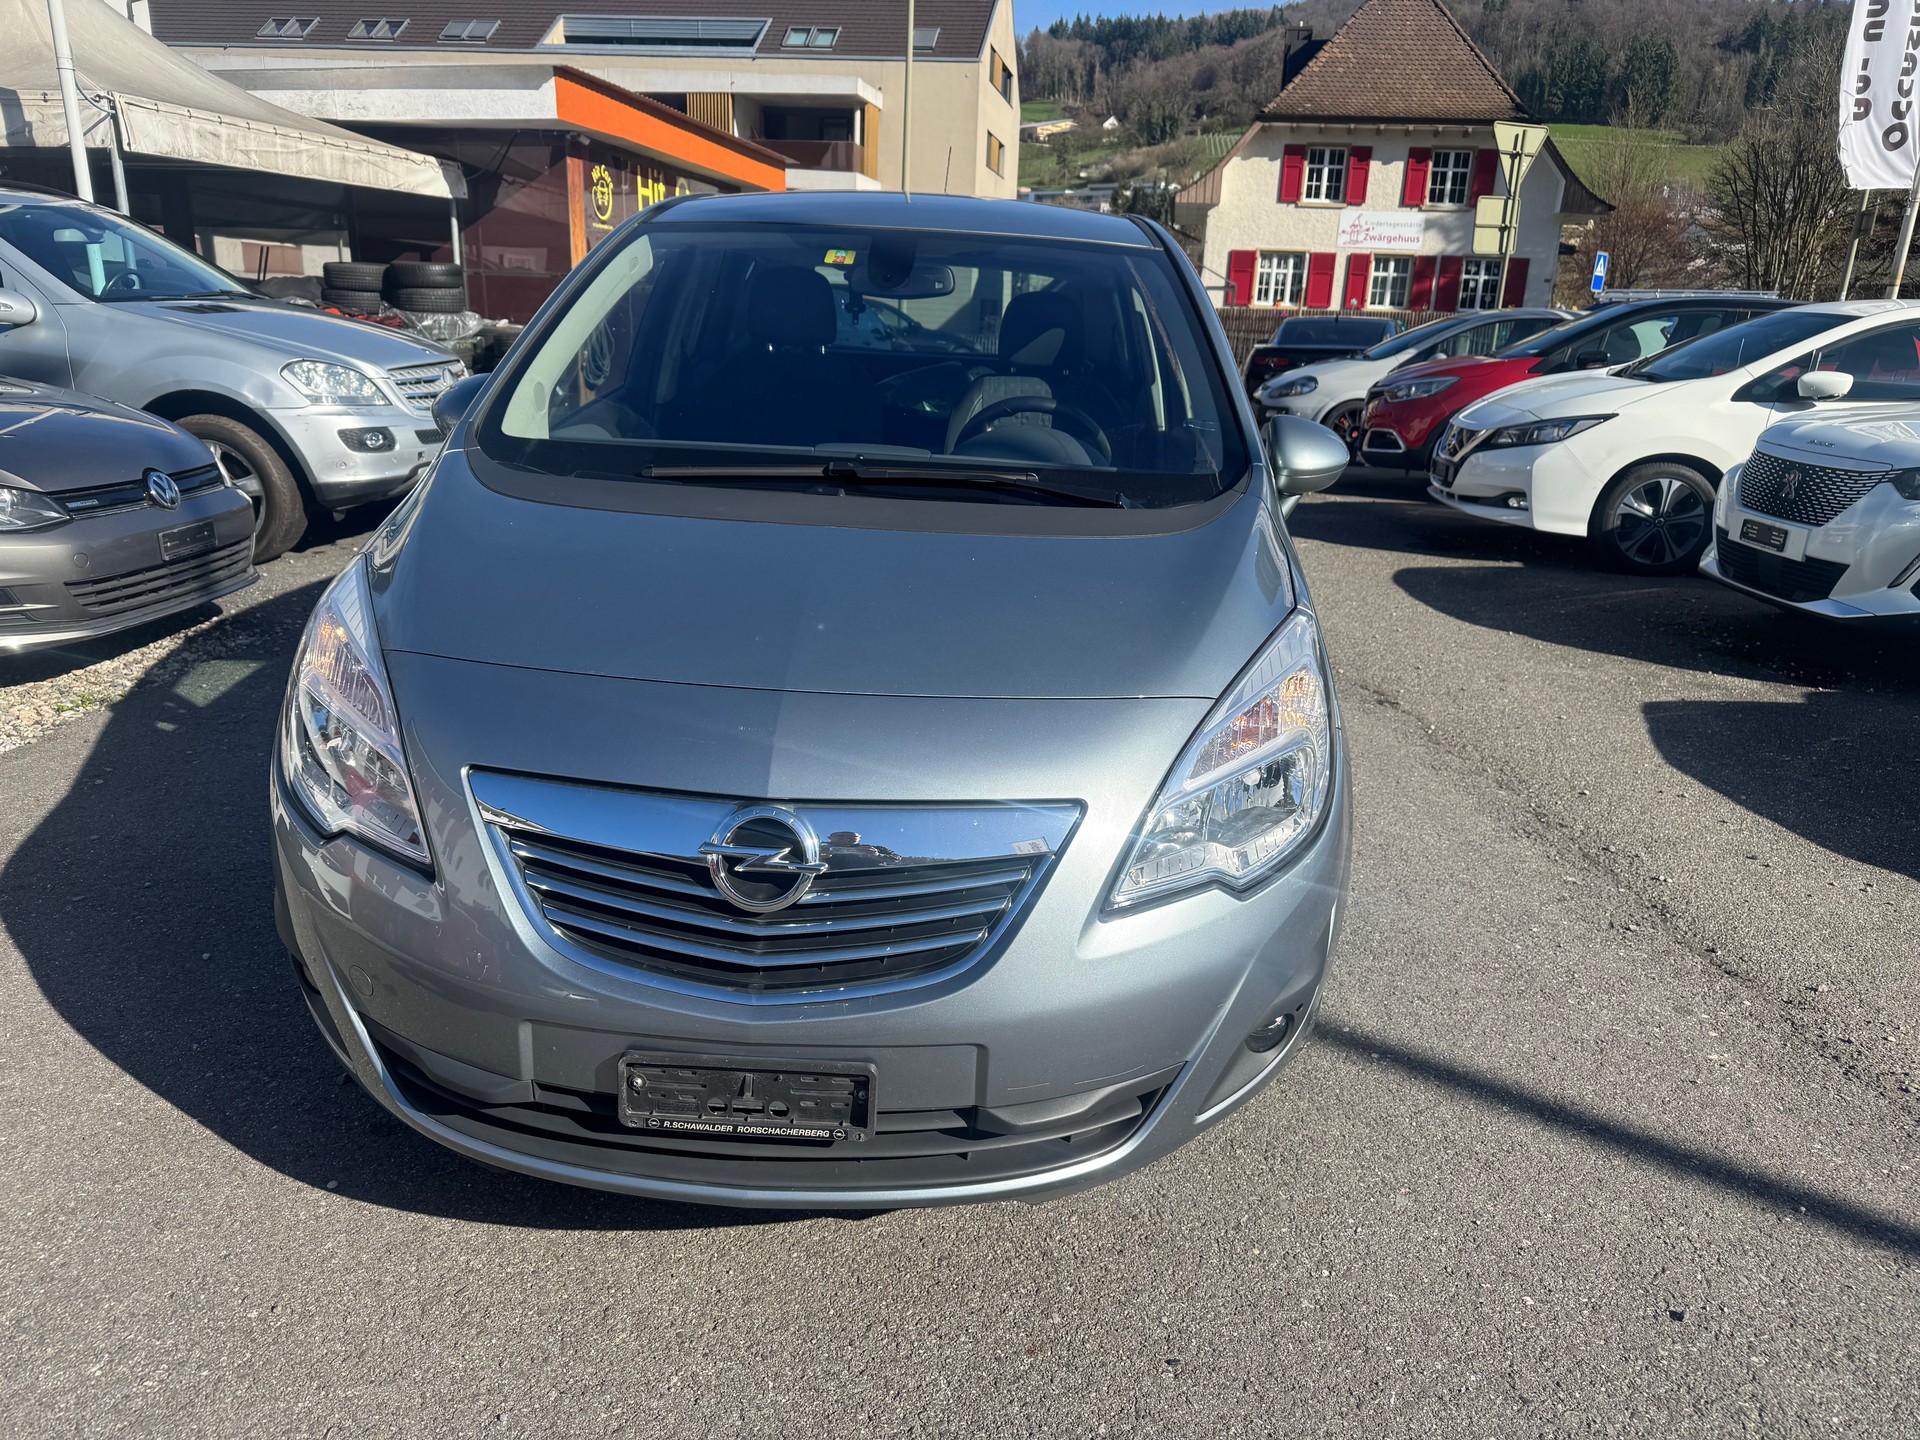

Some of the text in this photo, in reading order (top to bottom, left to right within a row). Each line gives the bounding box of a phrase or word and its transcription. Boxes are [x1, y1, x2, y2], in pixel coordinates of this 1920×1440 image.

[1363, 233, 1420, 244] Zwärgehuus
[663, 1121, 830, 1138] R.SCHAWALDER RORSCHACHERBERG
